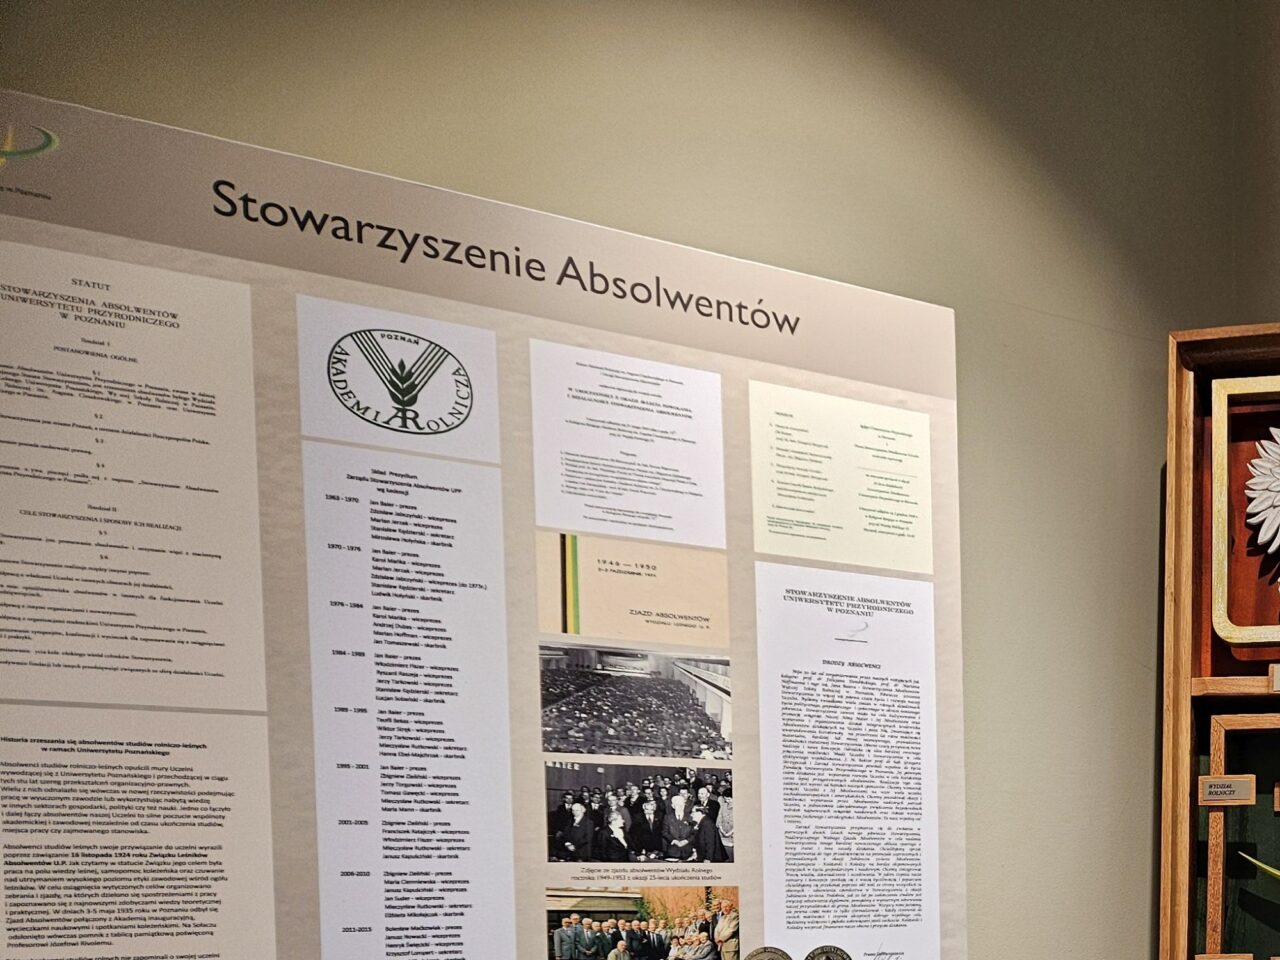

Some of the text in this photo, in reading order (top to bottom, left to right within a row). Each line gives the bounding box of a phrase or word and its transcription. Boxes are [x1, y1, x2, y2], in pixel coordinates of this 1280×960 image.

[212, 180, 800, 335] Stowarzyszenie Absolwentów
[72, 278, 111, 291] STATUT
[74, 314, 126, 329] POZNANIU
[381, 333, 419, 346] POZNAŃ
[783, 595, 914, 615] UNIWERSYTETU PRZYRODNICZEGO
[785, 589, 912, 608] STOWARZYSZENIE ABSOLWENTÓW
[836, 608, 874, 617] POZNANIU
